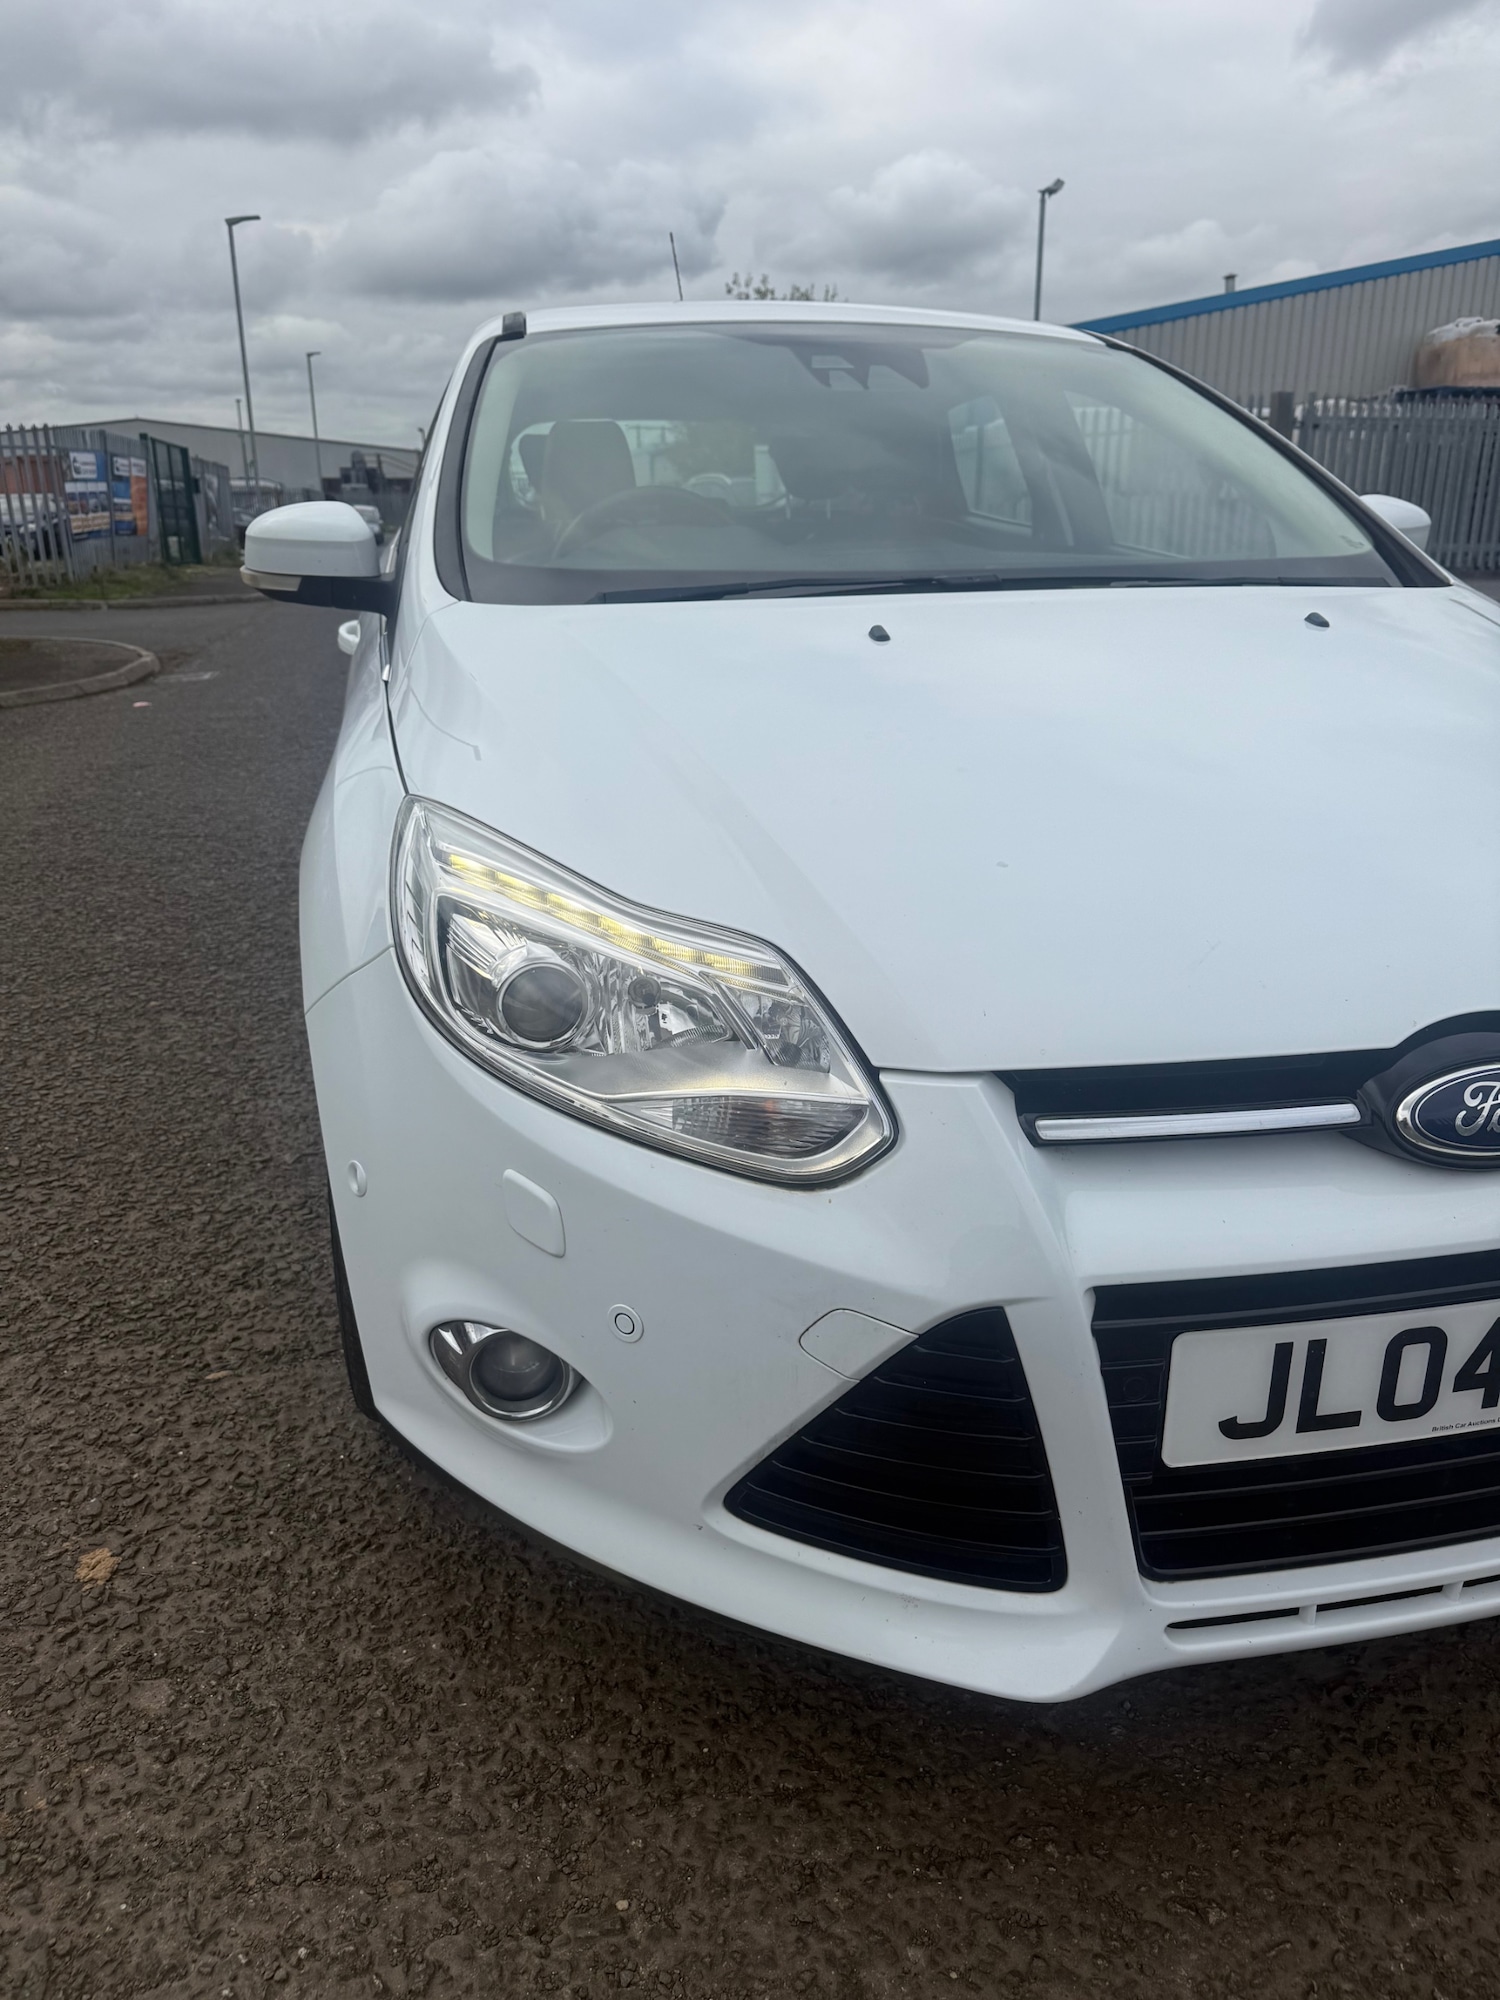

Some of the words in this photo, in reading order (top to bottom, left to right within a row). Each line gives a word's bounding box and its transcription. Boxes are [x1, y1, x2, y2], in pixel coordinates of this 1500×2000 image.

[1218, 1316, 1500, 1440] JL04
[1431, 1424, 1454, 1432] British
[1467, 1418, 1496, 1427] Auctions
